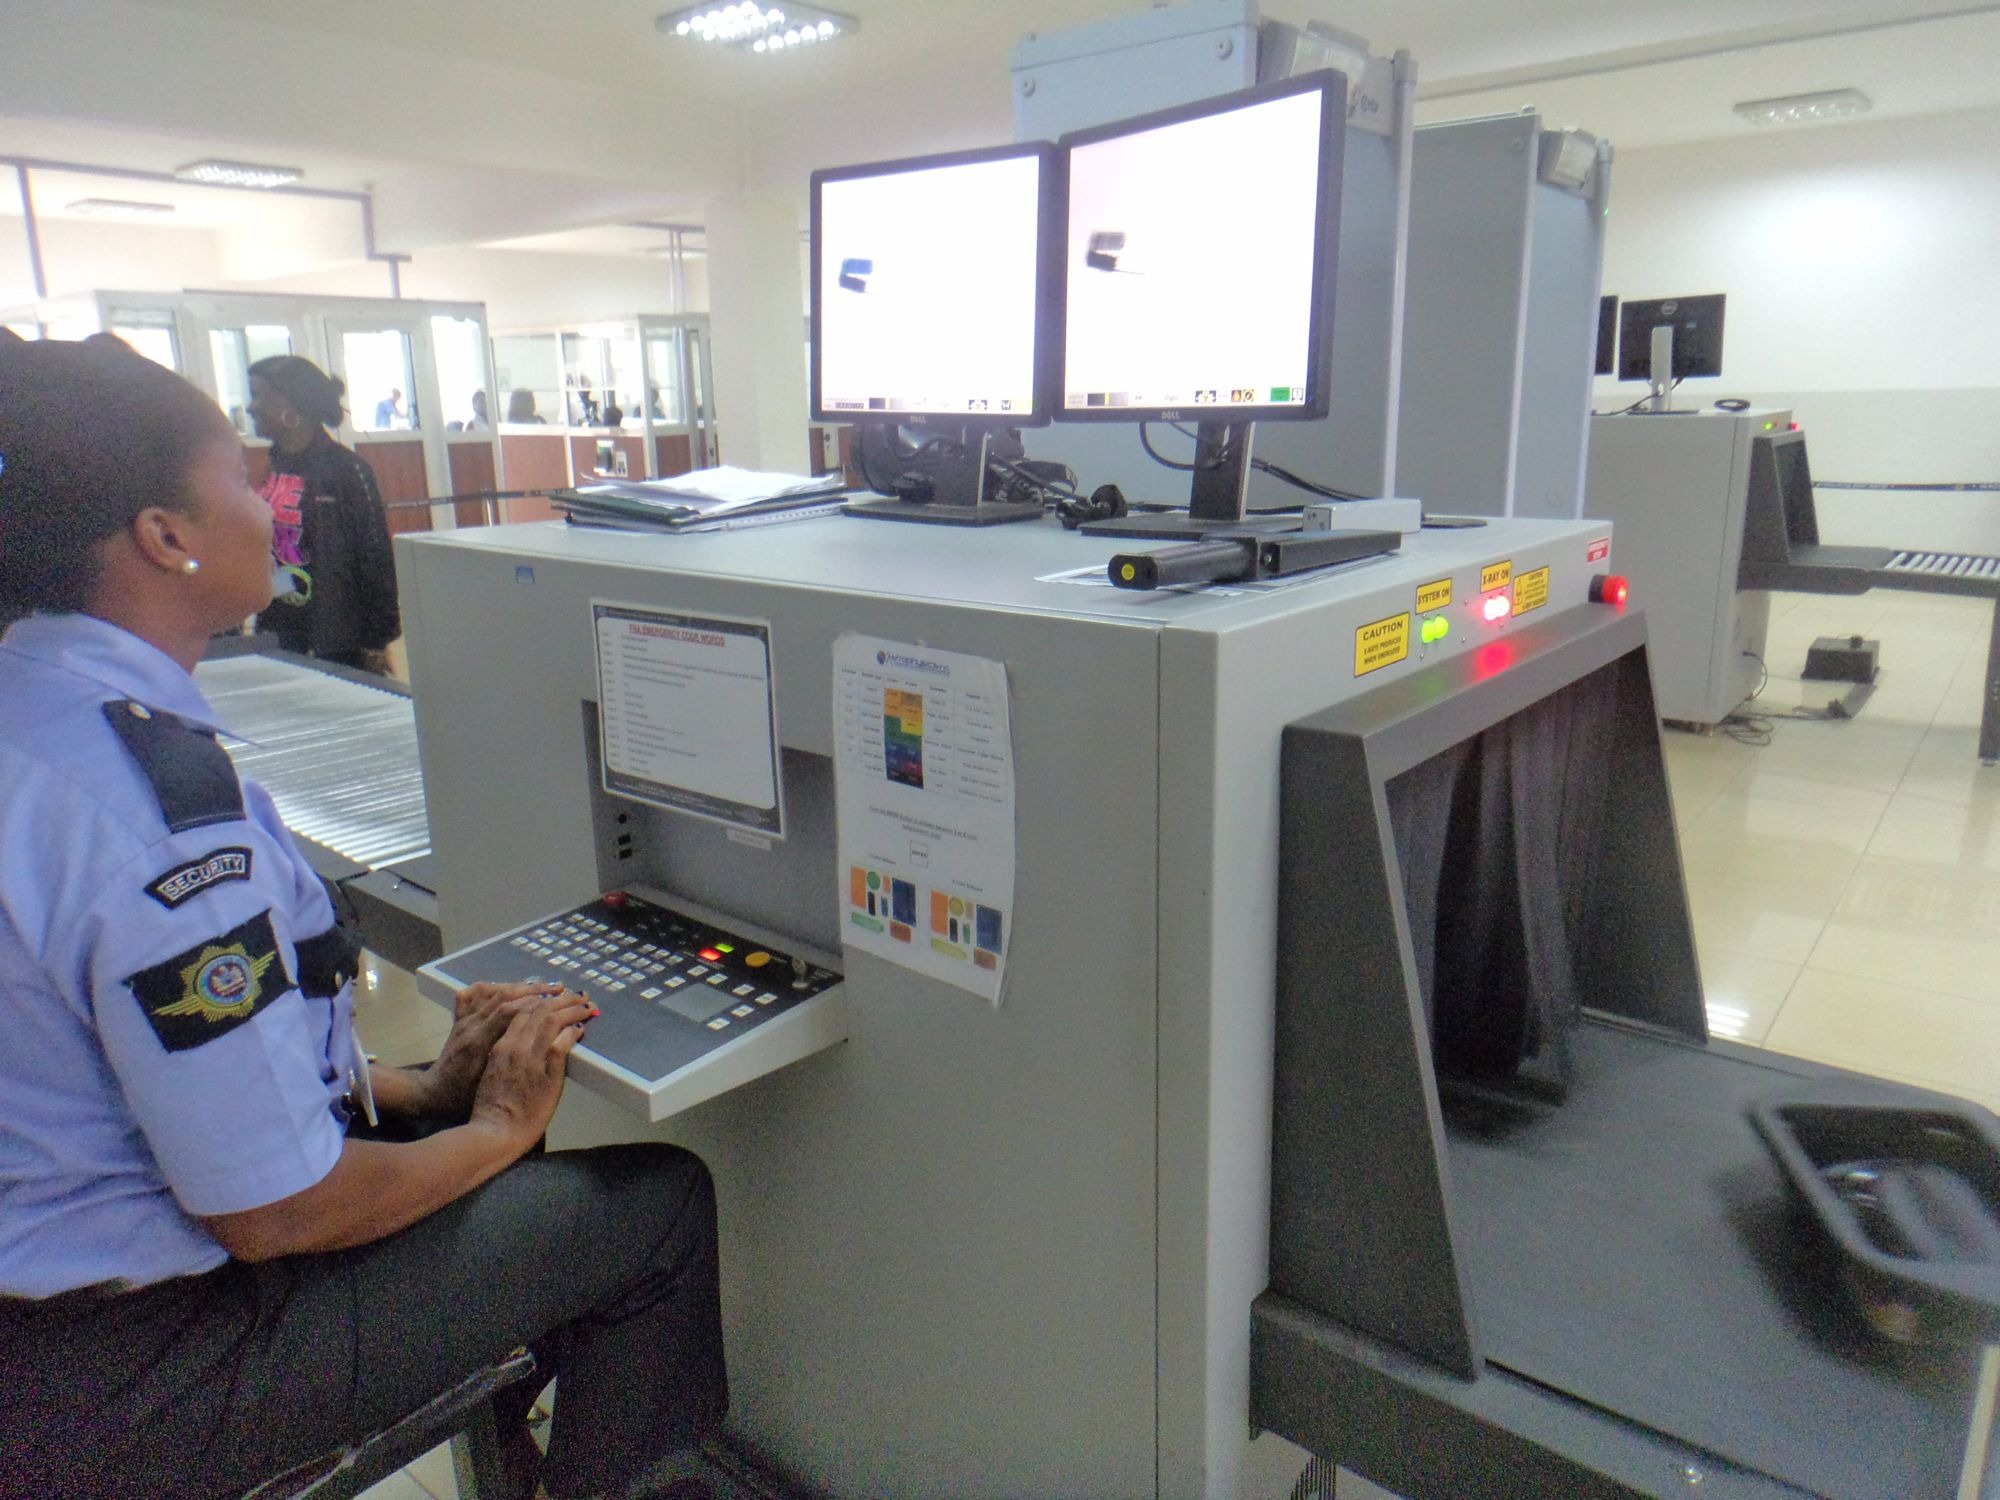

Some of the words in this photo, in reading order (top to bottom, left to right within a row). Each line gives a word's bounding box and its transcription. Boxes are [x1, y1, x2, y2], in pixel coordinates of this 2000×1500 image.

[1482, 571, 1499, 585] X-RAY
[1501, 568, 1510, 580] ON
[1417, 590, 1440, 606] SYSTEM
[1441, 587, 1450, 598] ON
[1363, 620, 1403, 641] CAUTION
[165, 855, 244, 896] SECURITY
